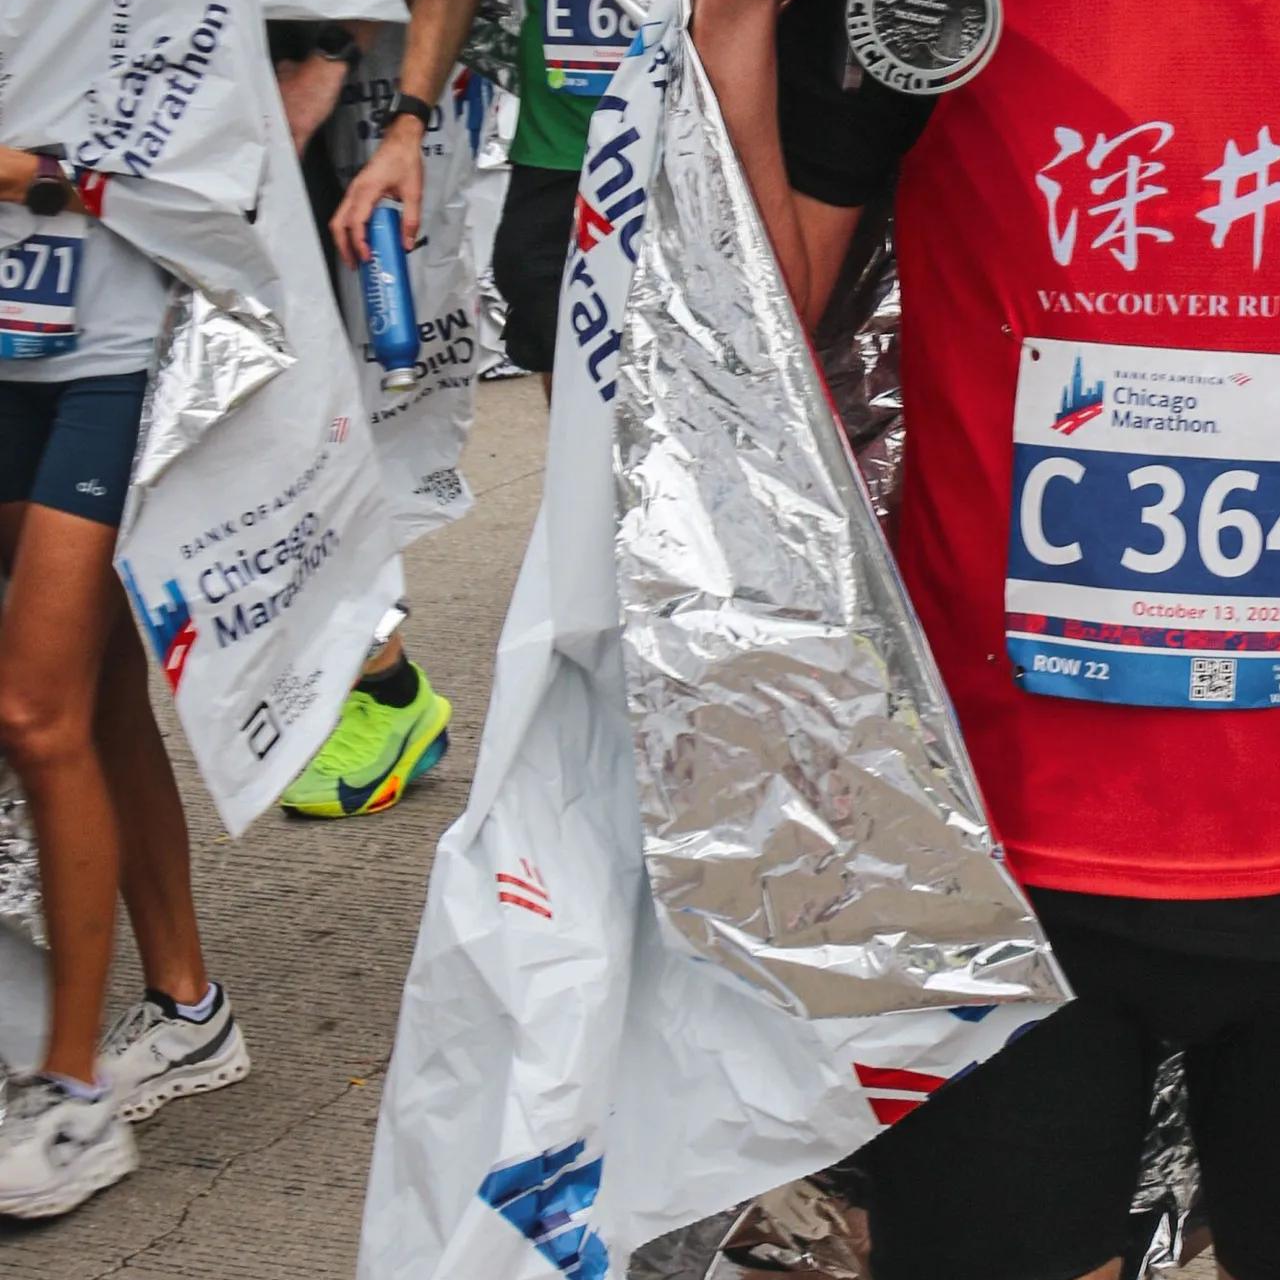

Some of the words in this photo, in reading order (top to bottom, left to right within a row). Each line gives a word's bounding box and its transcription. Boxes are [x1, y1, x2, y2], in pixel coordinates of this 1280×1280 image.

[1037, 290, 1229, 317] VANCOUVER
[1112, 386, 1198, 414] Chicago
[1020, 457, 1086, 566] C
[180, 522, 238, 560] BANK
[1132, 600, 1207, 621] October
[1033, 655, 1080, 675] ROW
[1085, 661, 1110, 680] 22
